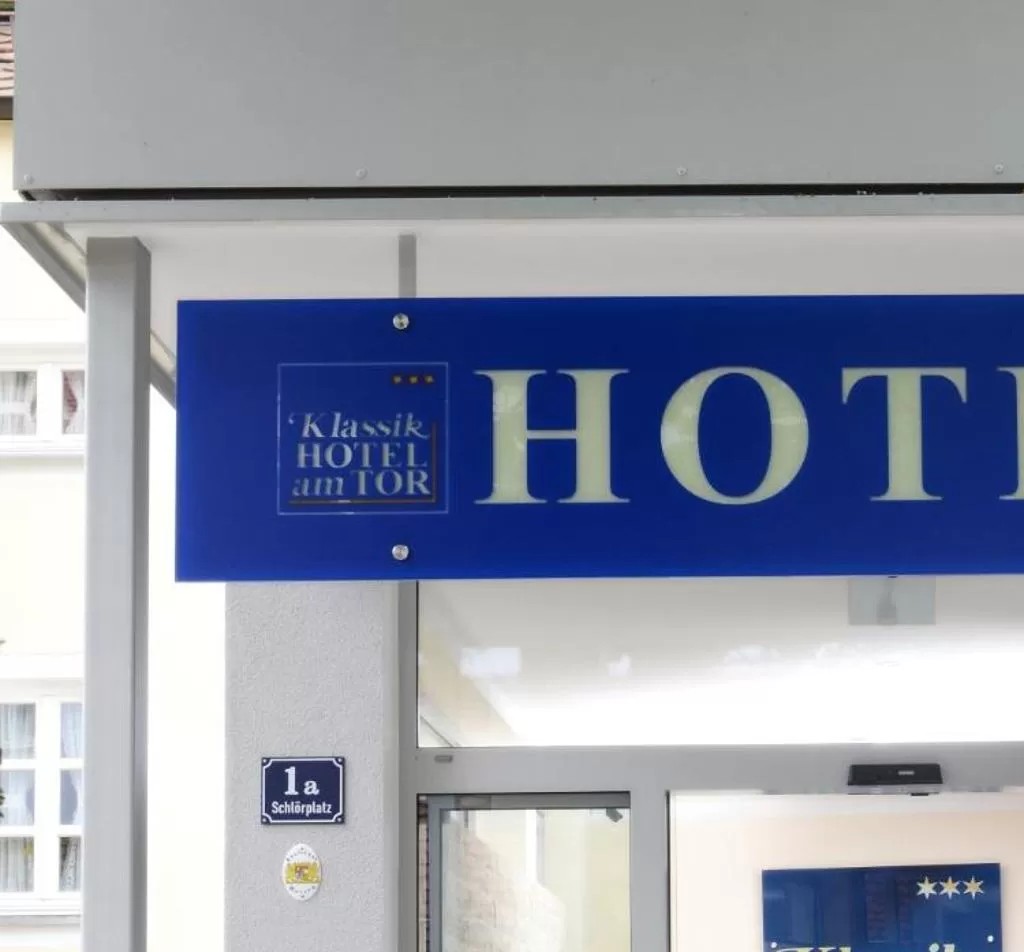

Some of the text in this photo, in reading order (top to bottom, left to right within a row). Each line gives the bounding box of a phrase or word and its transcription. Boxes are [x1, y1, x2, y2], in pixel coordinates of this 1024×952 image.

[289, 412, 430, 439] Klassik
[297, 441, 428, 469] HOTEL
[292, 469, 432, 497] am TOR
[271, 800, 332, 817] Schlörplatz
